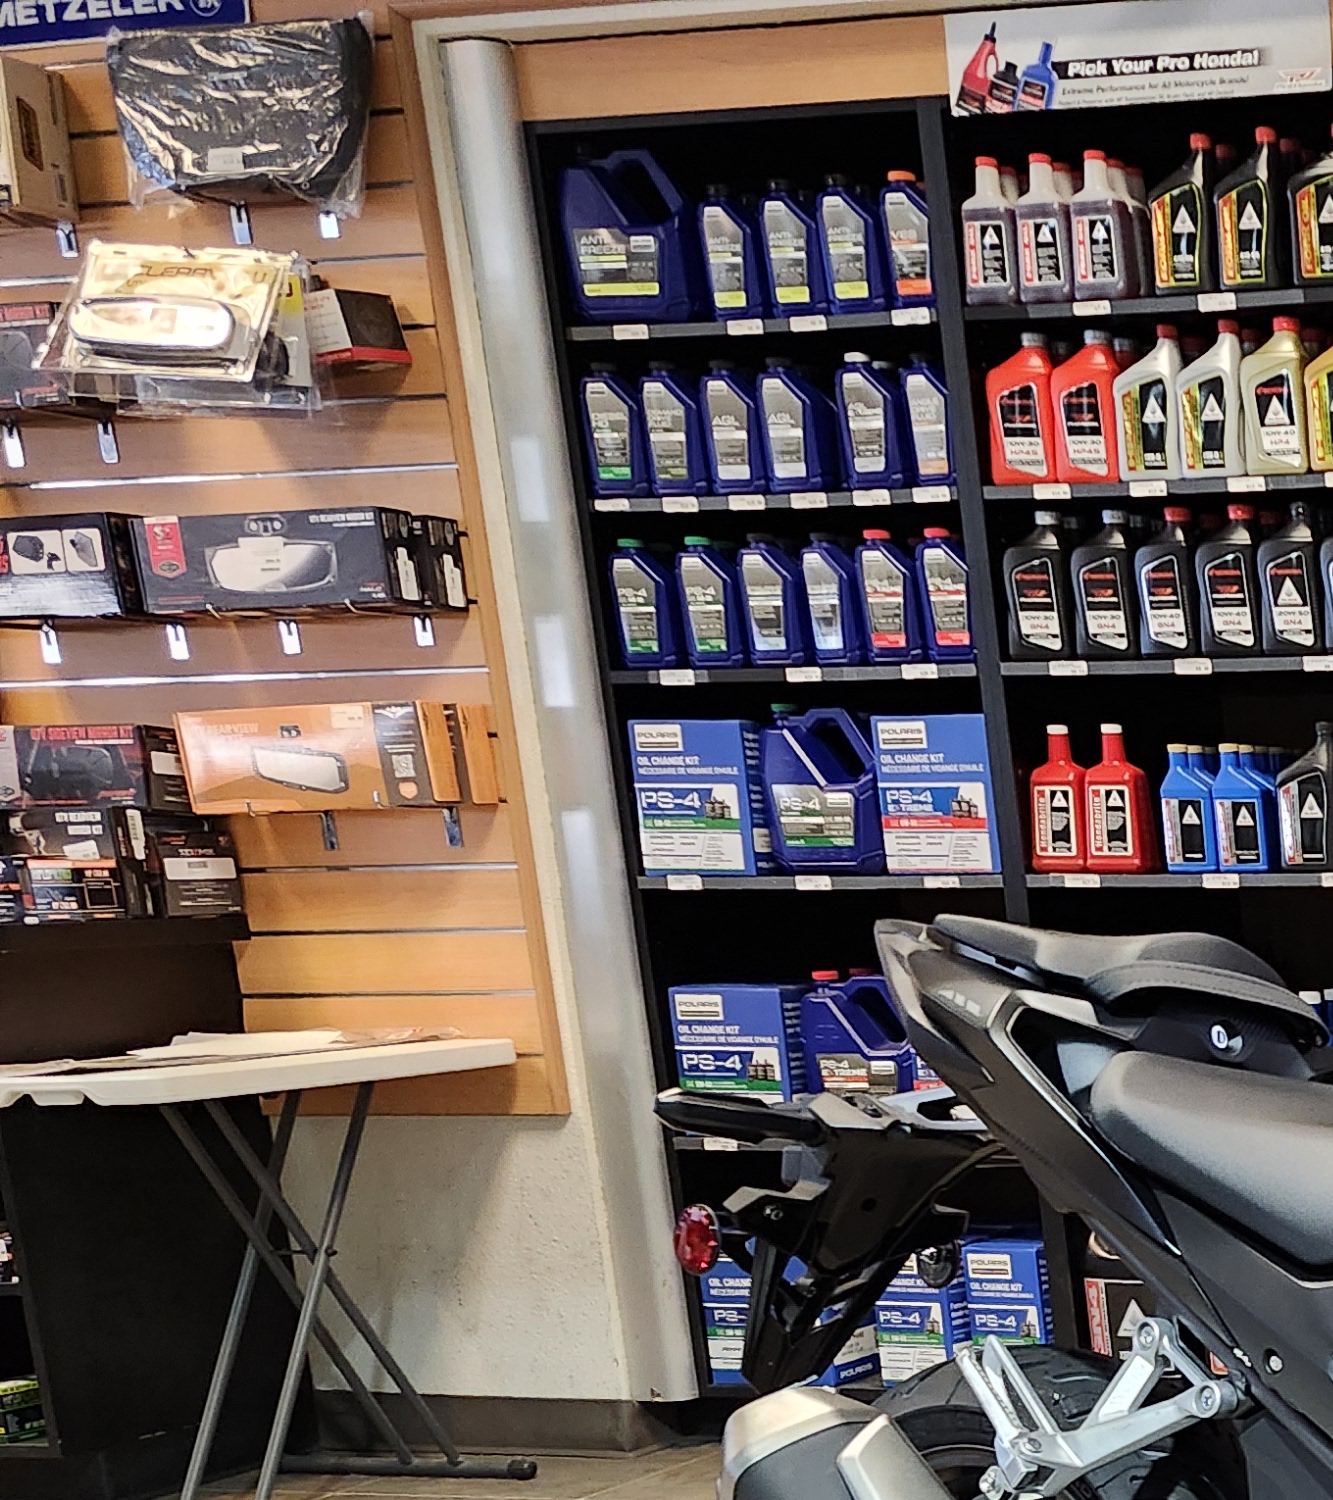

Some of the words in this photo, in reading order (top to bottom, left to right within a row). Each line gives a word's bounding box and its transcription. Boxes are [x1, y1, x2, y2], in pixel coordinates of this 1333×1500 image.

[1068, 60, 1108, 77] Pick
[1111, 57, 1153, 75] Your
[1157, 54, 1190, 73] Pro
[1193, 50, 1260, 69] Honda!
[1096, 83, 1146, 94] Performance
[1157, 621, 1175, 629] GN4
[1283, 618, 1303, 626] GN4
[637, 730, 679, 740] POLARIS
[880, 728, 923, 737] POLARIS
[652, 756, 682, 766] CHANGE
[684, 755, 701, 766] KIT
[895, 754, 925, 764] CHANGE
[927, 753, 943, 763] KIT
[641, 790, 702, 809] PS-4
[886, 789, 933, 805] PS-4
[780, 796, 821, 811] PS-4
[1039, 794, 1048, 850] Hondabrite
[1094, 794, 1102, 850] Hondabrite
[678, 1001, 719, 1009] POLARIS
[678, 1025, 690, 1034] OIL
[692, 1025, 725, 1035] CHANGE
[727, 1025, 740, 1034] KIT
[682, 1053, 743, 1071] PS-4
[820, 1059, 848, 1069] PS-4
[969, 1258, 1009, 1268] POLARIS
[879, 1311, 921, 1325] PS-4
[975, 1314, 1017, 1328] PS-4
[839, 1363, 873, 1379] POLARIS
